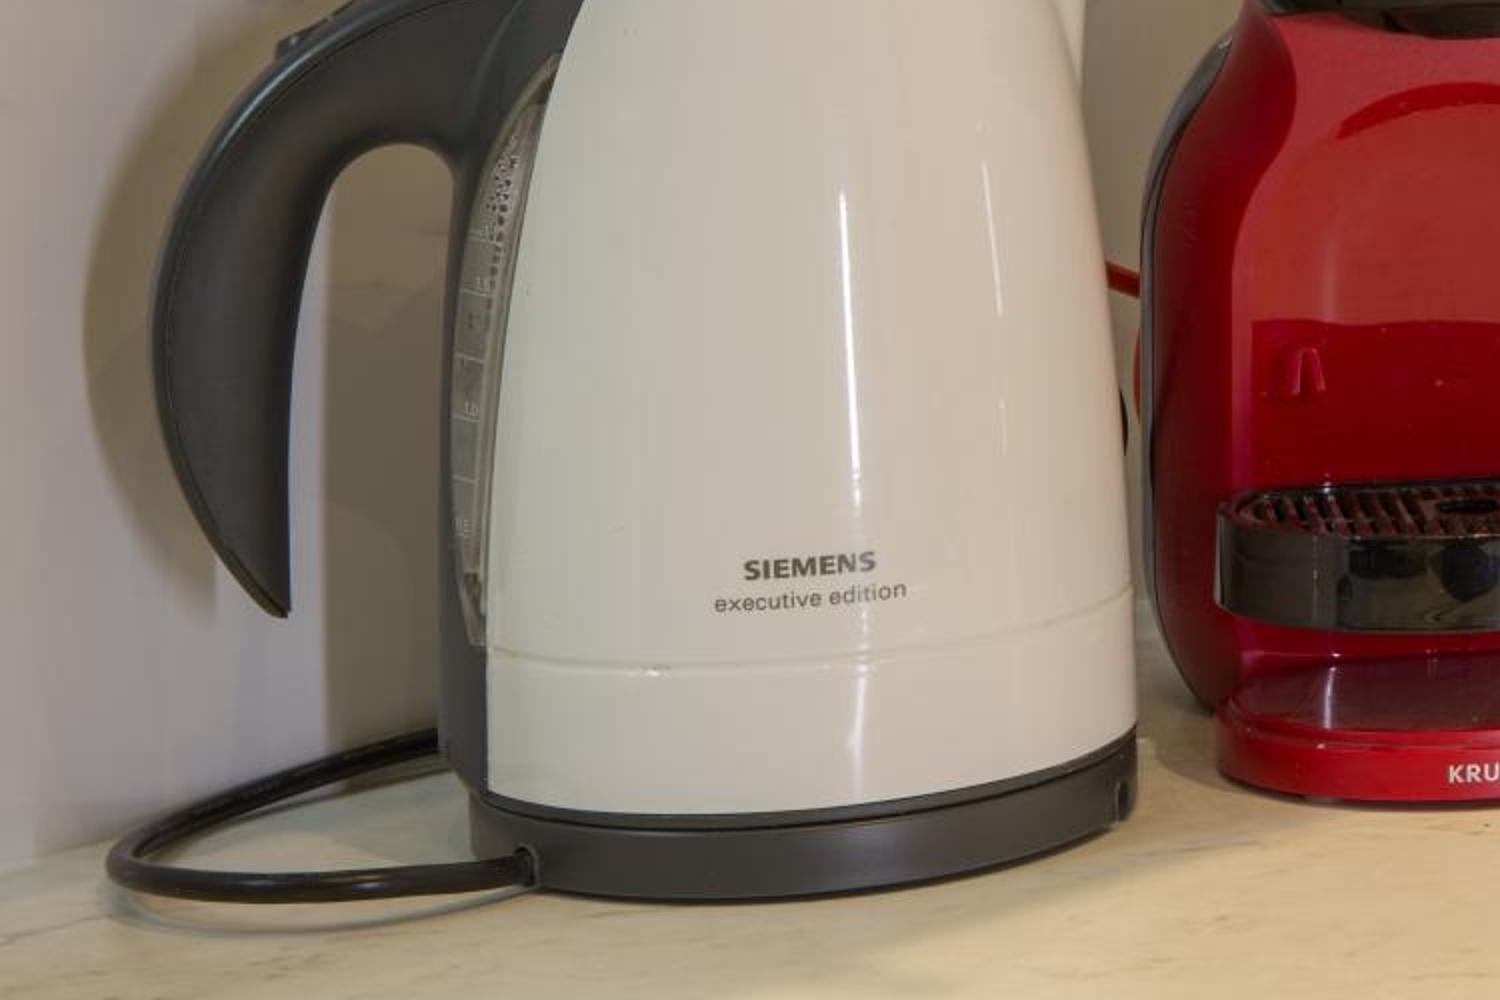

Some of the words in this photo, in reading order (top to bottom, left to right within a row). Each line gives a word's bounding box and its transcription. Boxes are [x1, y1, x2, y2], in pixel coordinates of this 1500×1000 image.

[744, 551, 876, 581] SIEMENS
[714, 591, 822, 612] executive
[829, 583, 907, 605] edition
